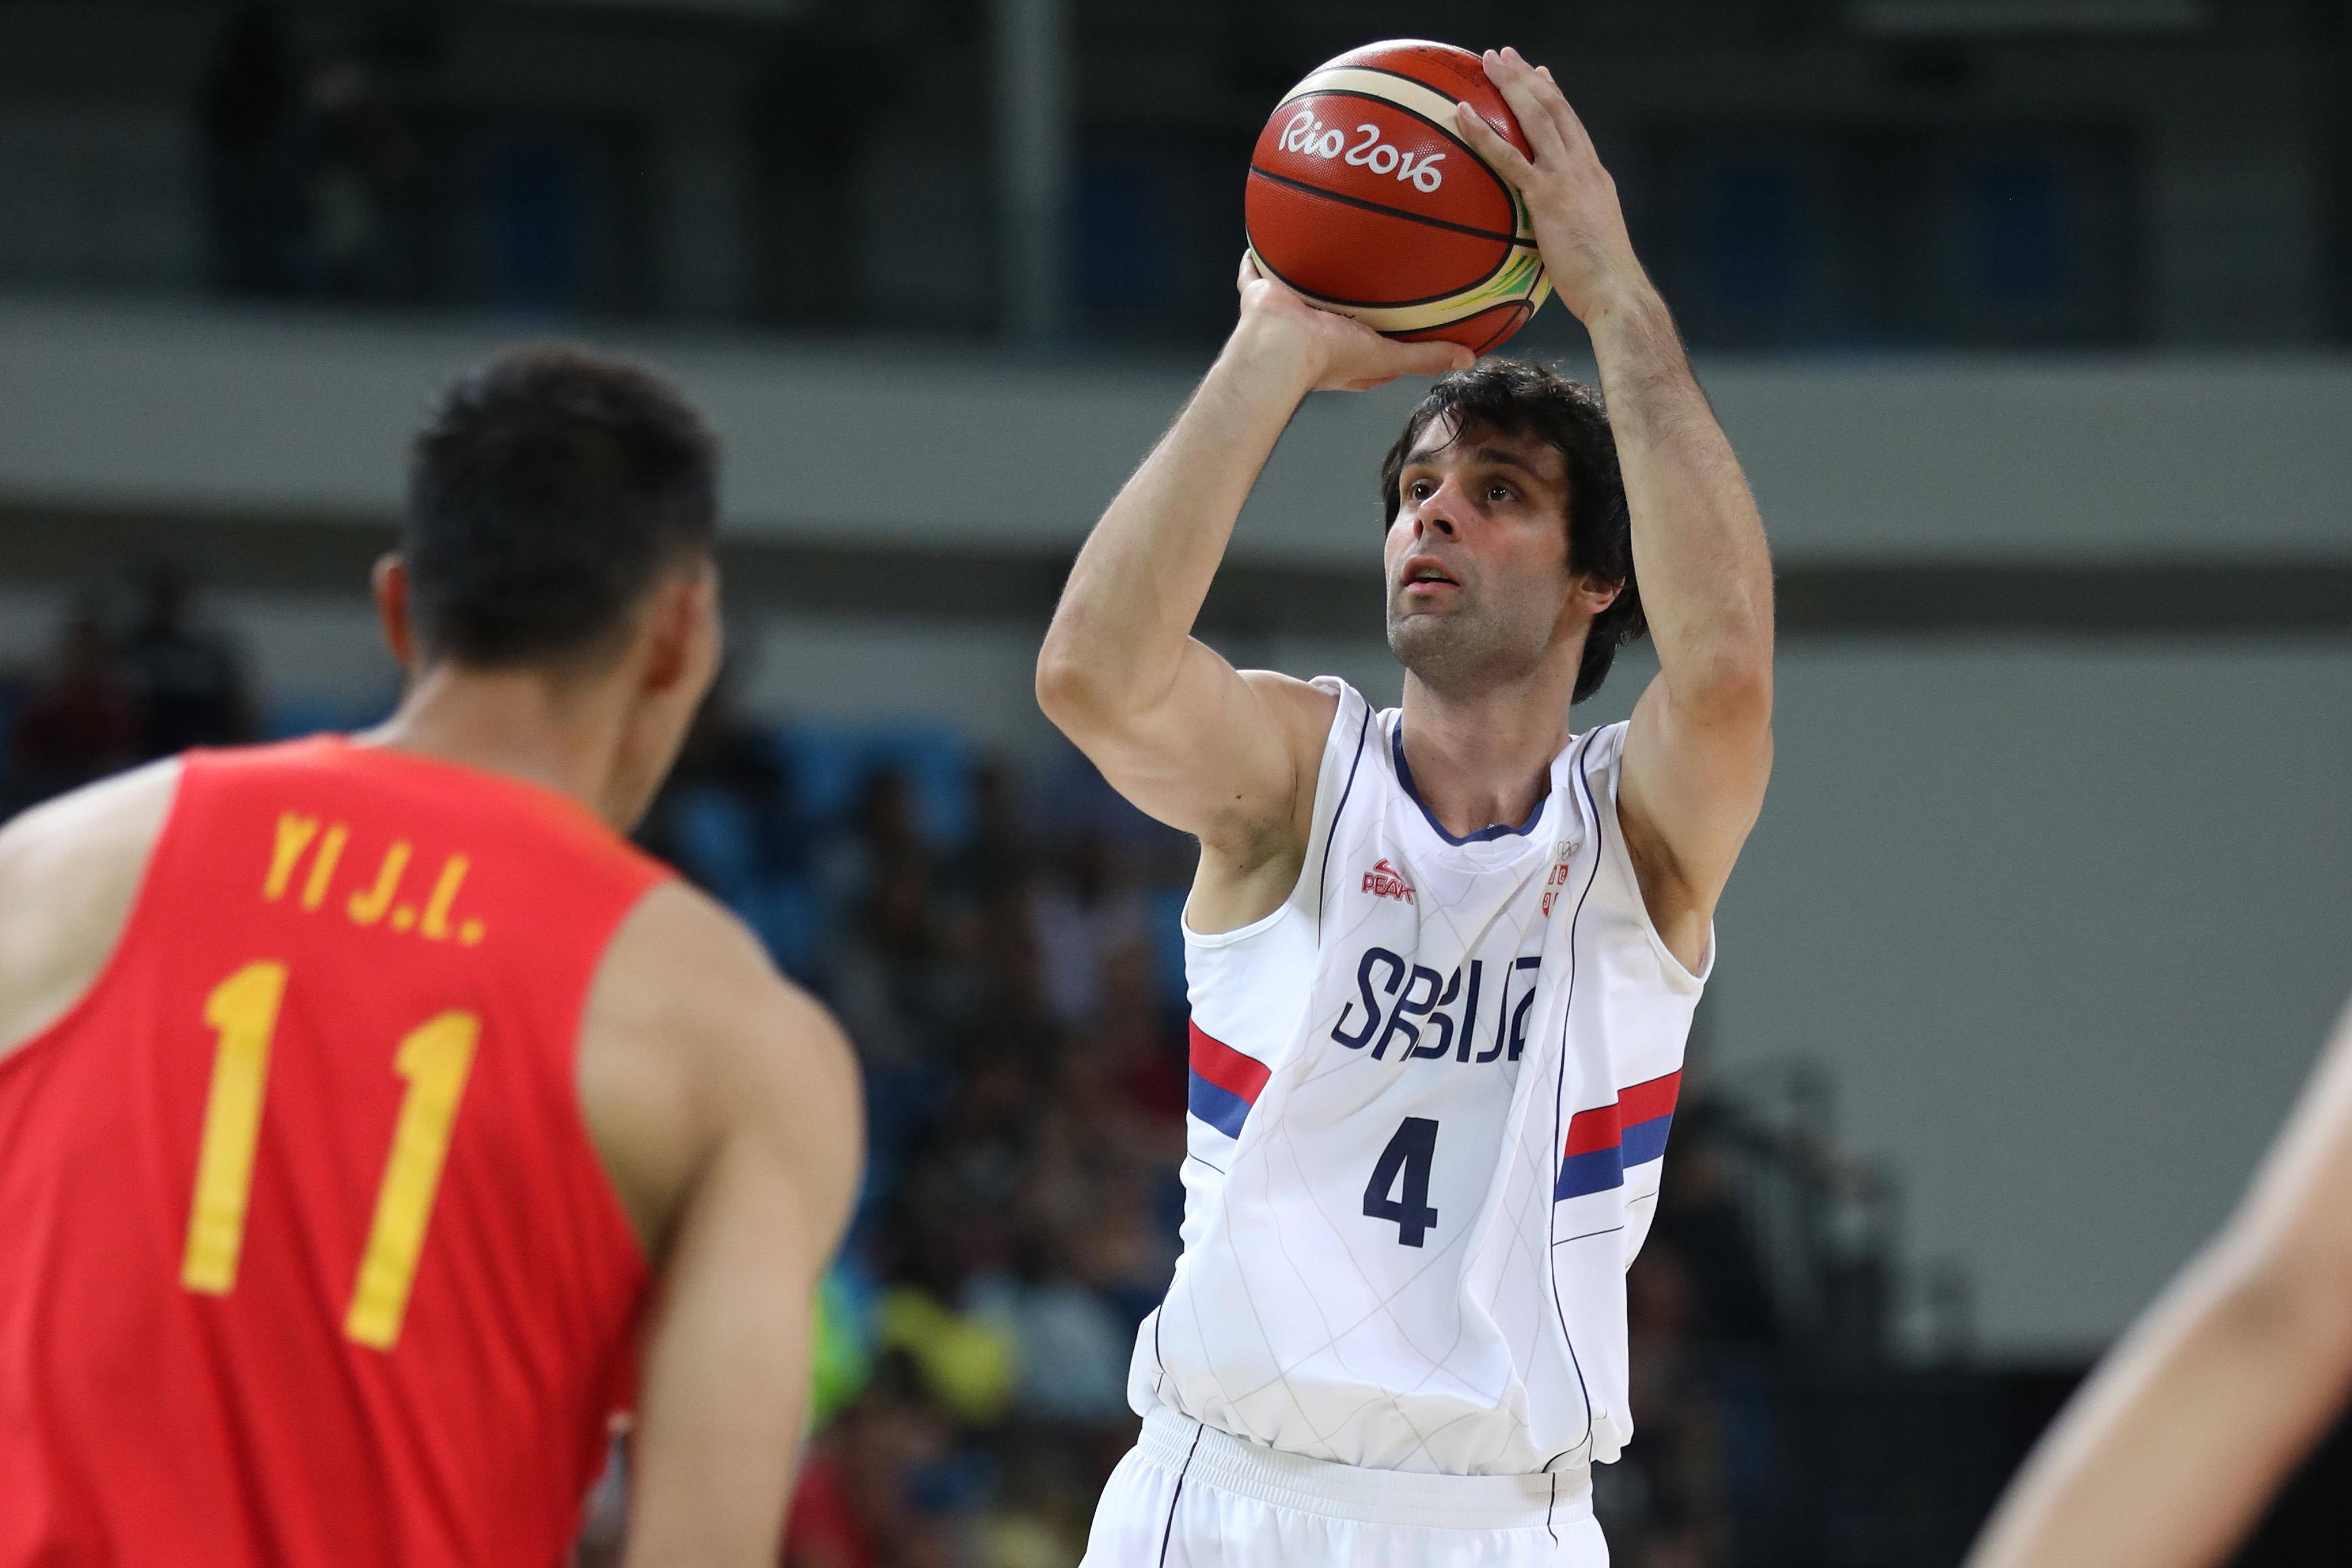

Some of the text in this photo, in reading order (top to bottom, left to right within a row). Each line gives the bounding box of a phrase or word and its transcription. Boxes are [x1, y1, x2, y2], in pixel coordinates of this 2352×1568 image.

[1278, 110, 1446, 193] Rio 2016
[264, 812, 347, 911] YI
[1361, 871, 1415, 905] PEAK
[181, 958, 480, 1350] 11
[1363, 1117, 1439, 1248] 4
